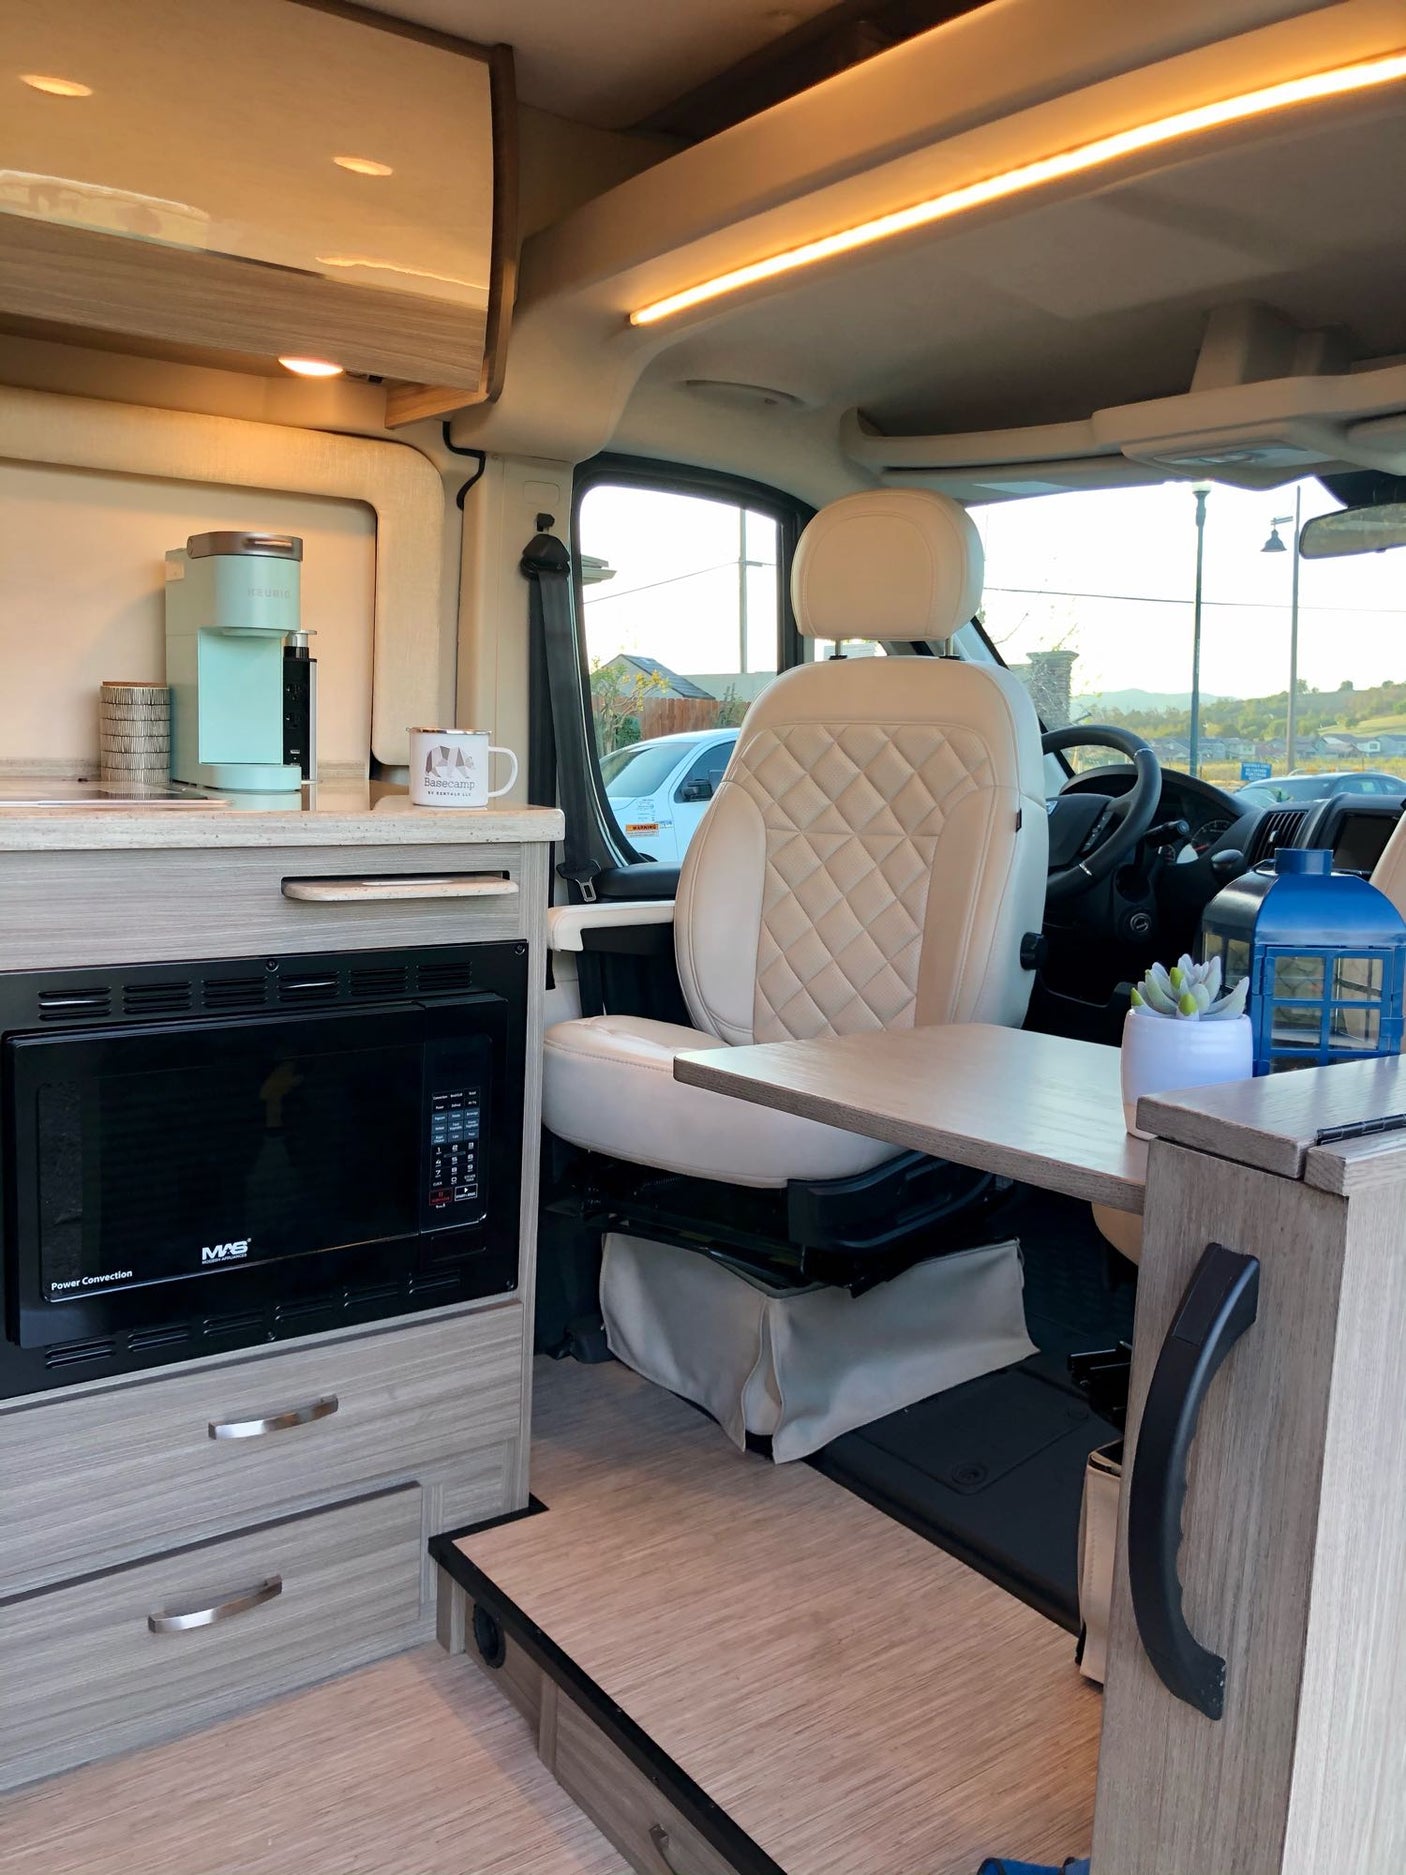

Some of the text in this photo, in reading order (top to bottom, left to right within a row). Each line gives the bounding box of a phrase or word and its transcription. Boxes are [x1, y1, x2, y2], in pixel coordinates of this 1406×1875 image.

[424, 777, 475, 791] Basecamp
[202, 1240, 248, 1260] MAS
[51, 1270, 133, 1291] Power Convection
